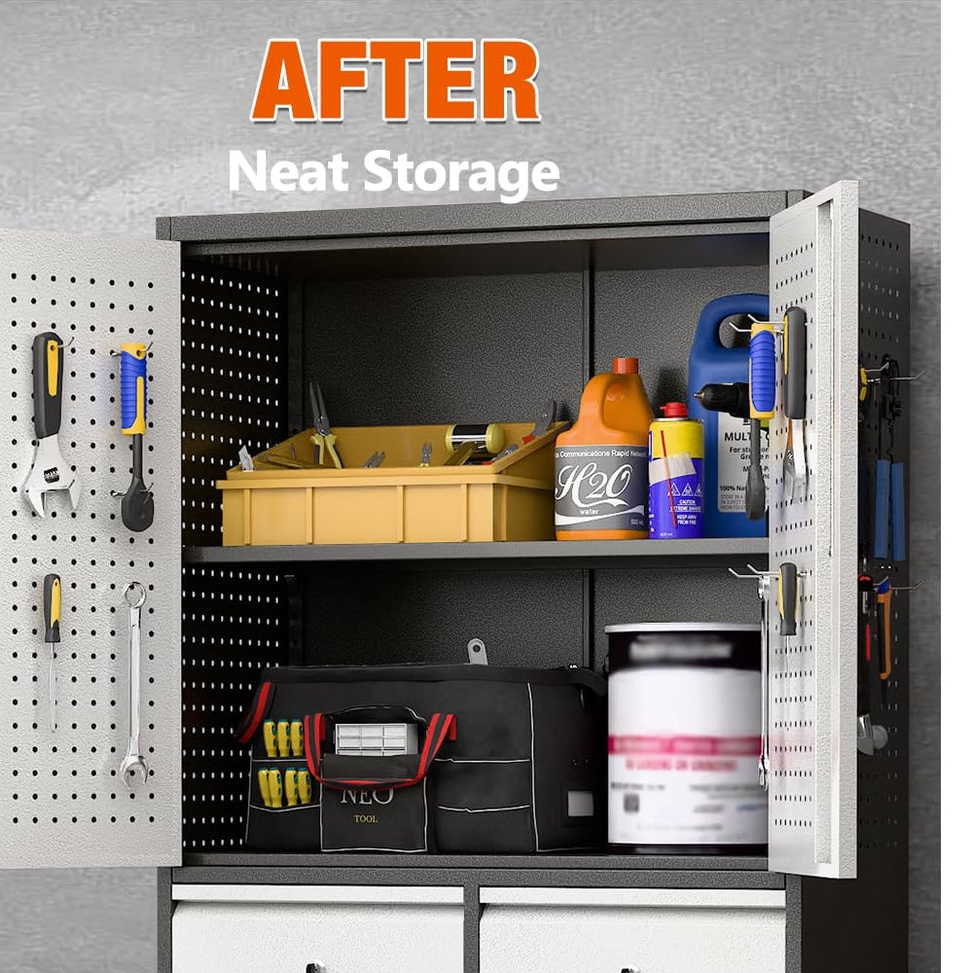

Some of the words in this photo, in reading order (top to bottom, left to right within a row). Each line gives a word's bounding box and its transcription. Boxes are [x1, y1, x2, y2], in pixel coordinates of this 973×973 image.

[611, 449, 629, 458] Rapid
[555, 462, 633, 508] H2O
[354, 814, 379, 823] TOOL
